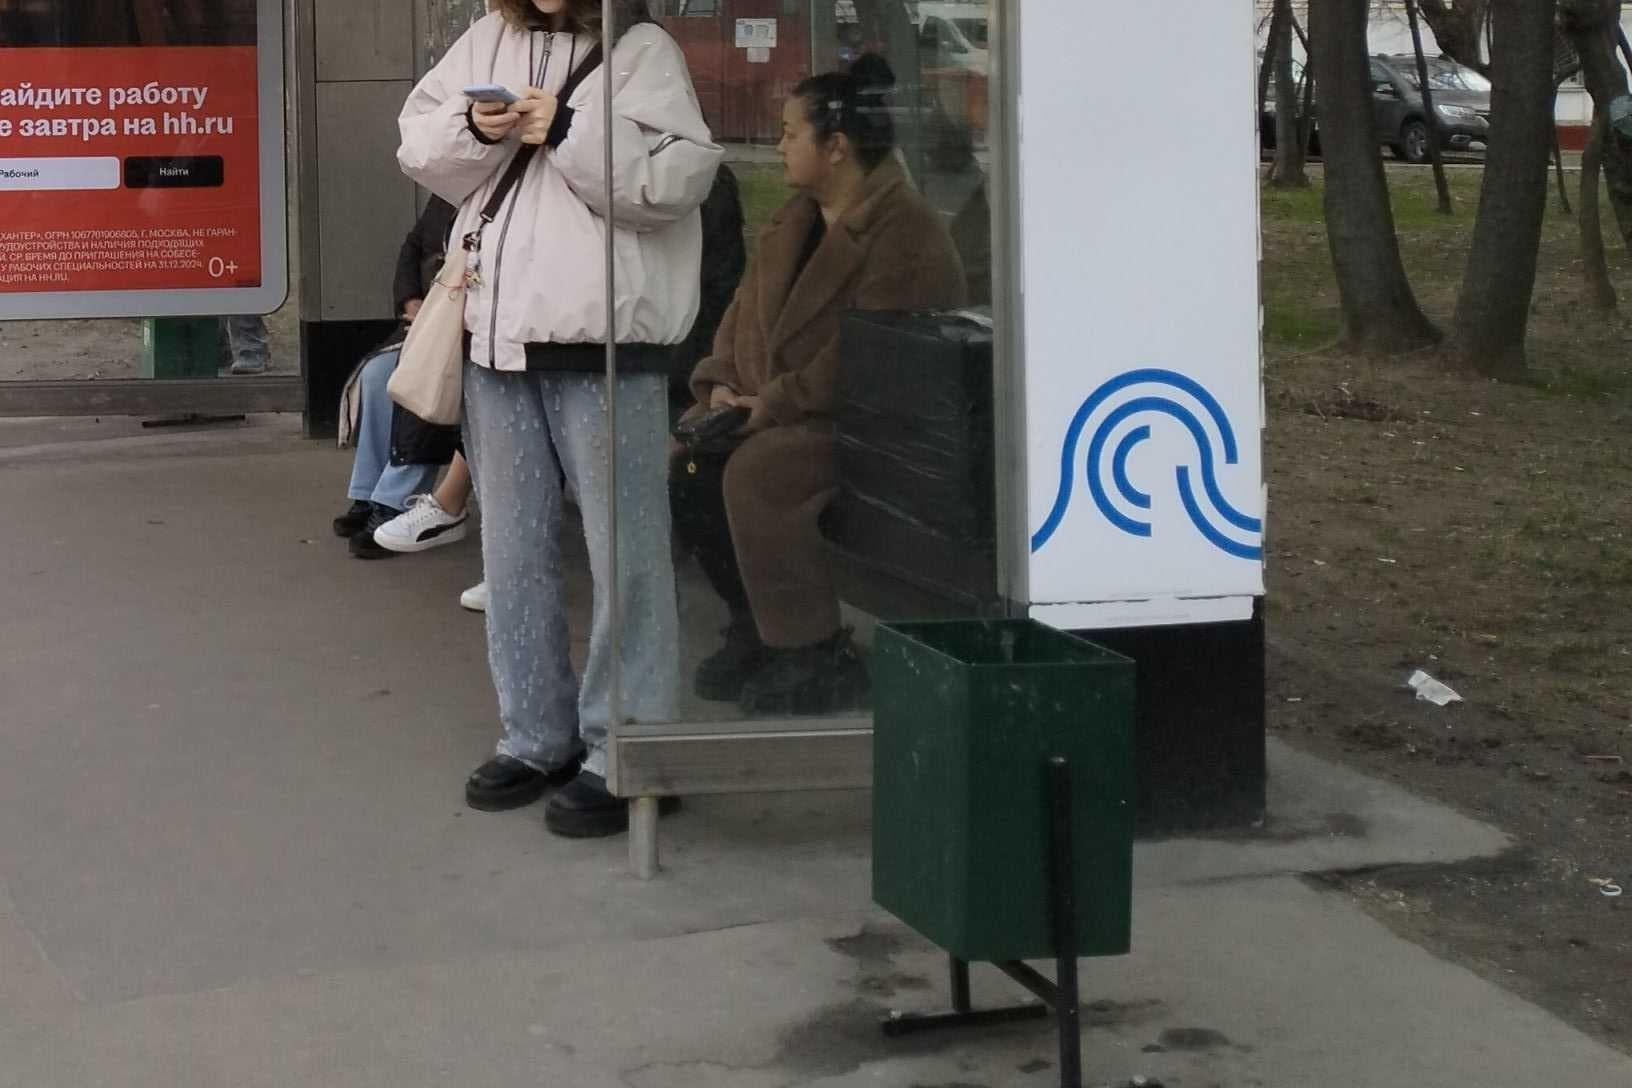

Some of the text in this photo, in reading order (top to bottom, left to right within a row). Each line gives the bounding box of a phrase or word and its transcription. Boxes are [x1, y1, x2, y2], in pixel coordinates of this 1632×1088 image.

[108, 81, 208, 110] работу
[19, 117, 117, 141] завтра
[123, 117, 156, 136] на
[163, 112, 233, 135] hh.ru
[159, 167, 189, 177] Найти
[208, 256, 238, 278] 0+
